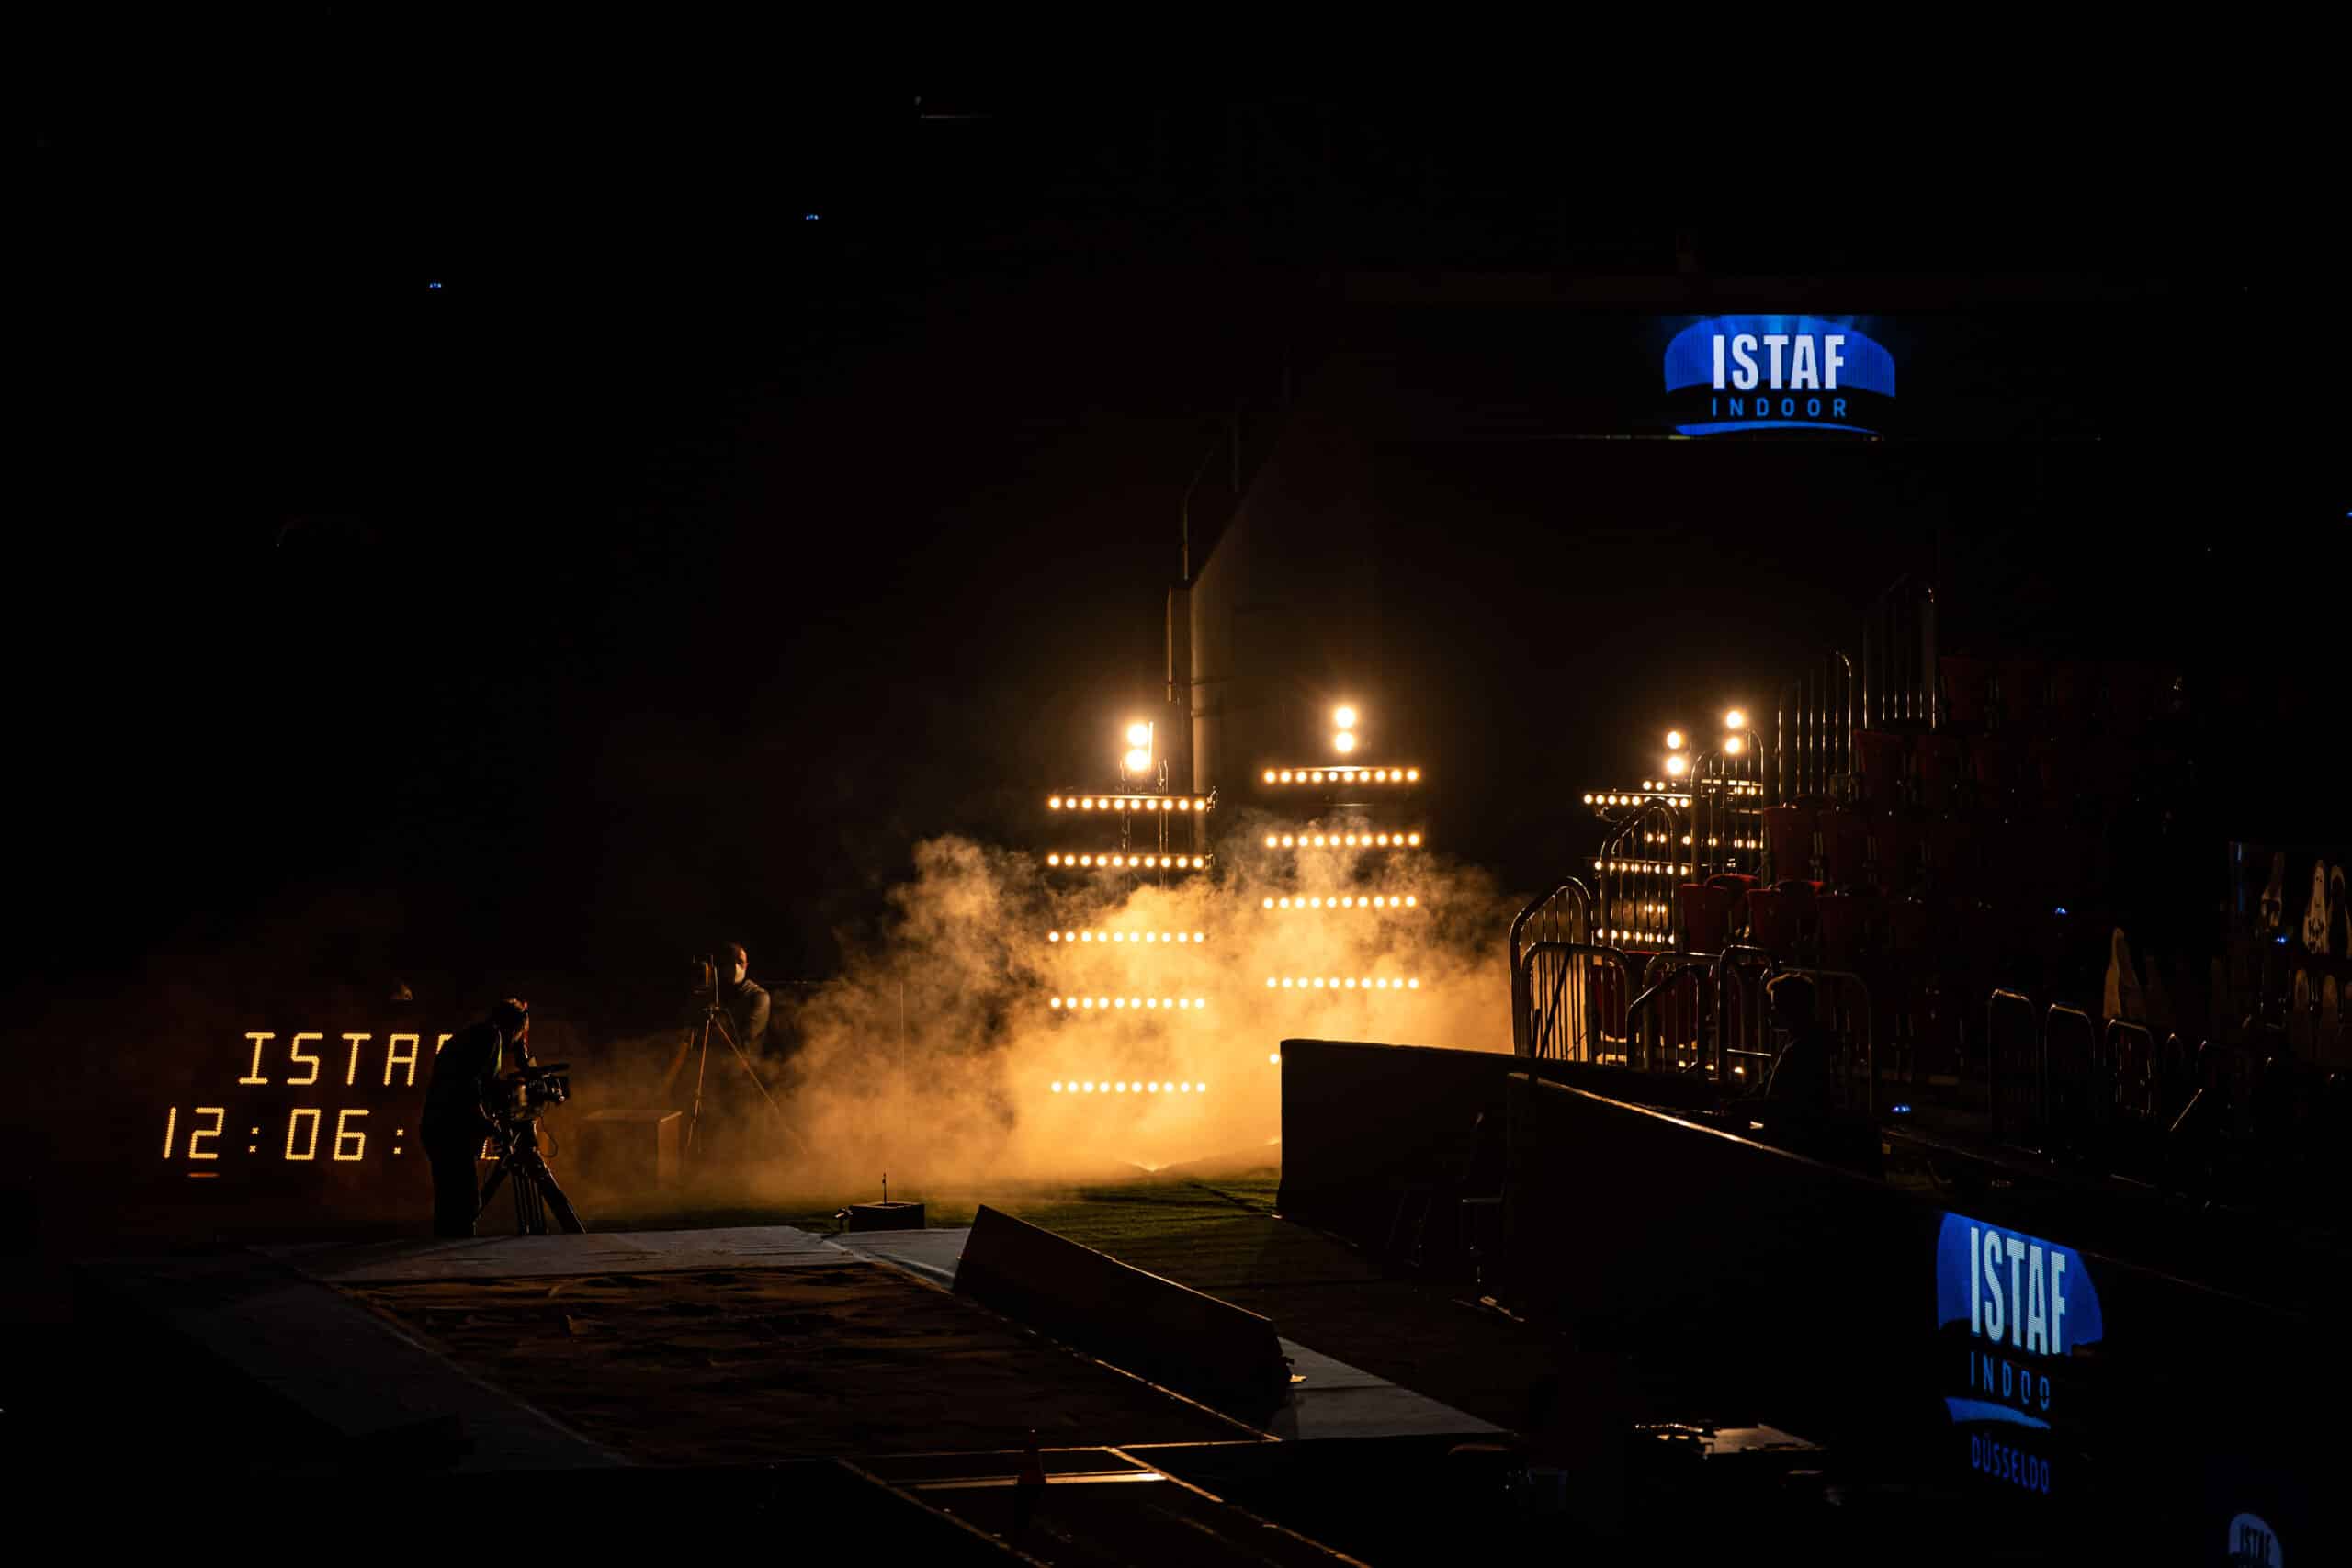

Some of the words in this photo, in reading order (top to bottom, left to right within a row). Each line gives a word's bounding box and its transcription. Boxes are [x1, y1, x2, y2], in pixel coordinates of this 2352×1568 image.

[1713, 334, 1845, 390] ISTAF
[1712, 398, 1847, 417] INDOOR
[162, 1106, 501, 1161] 12:06:
[1970, 1226, 2066, 1355] ISTAF
